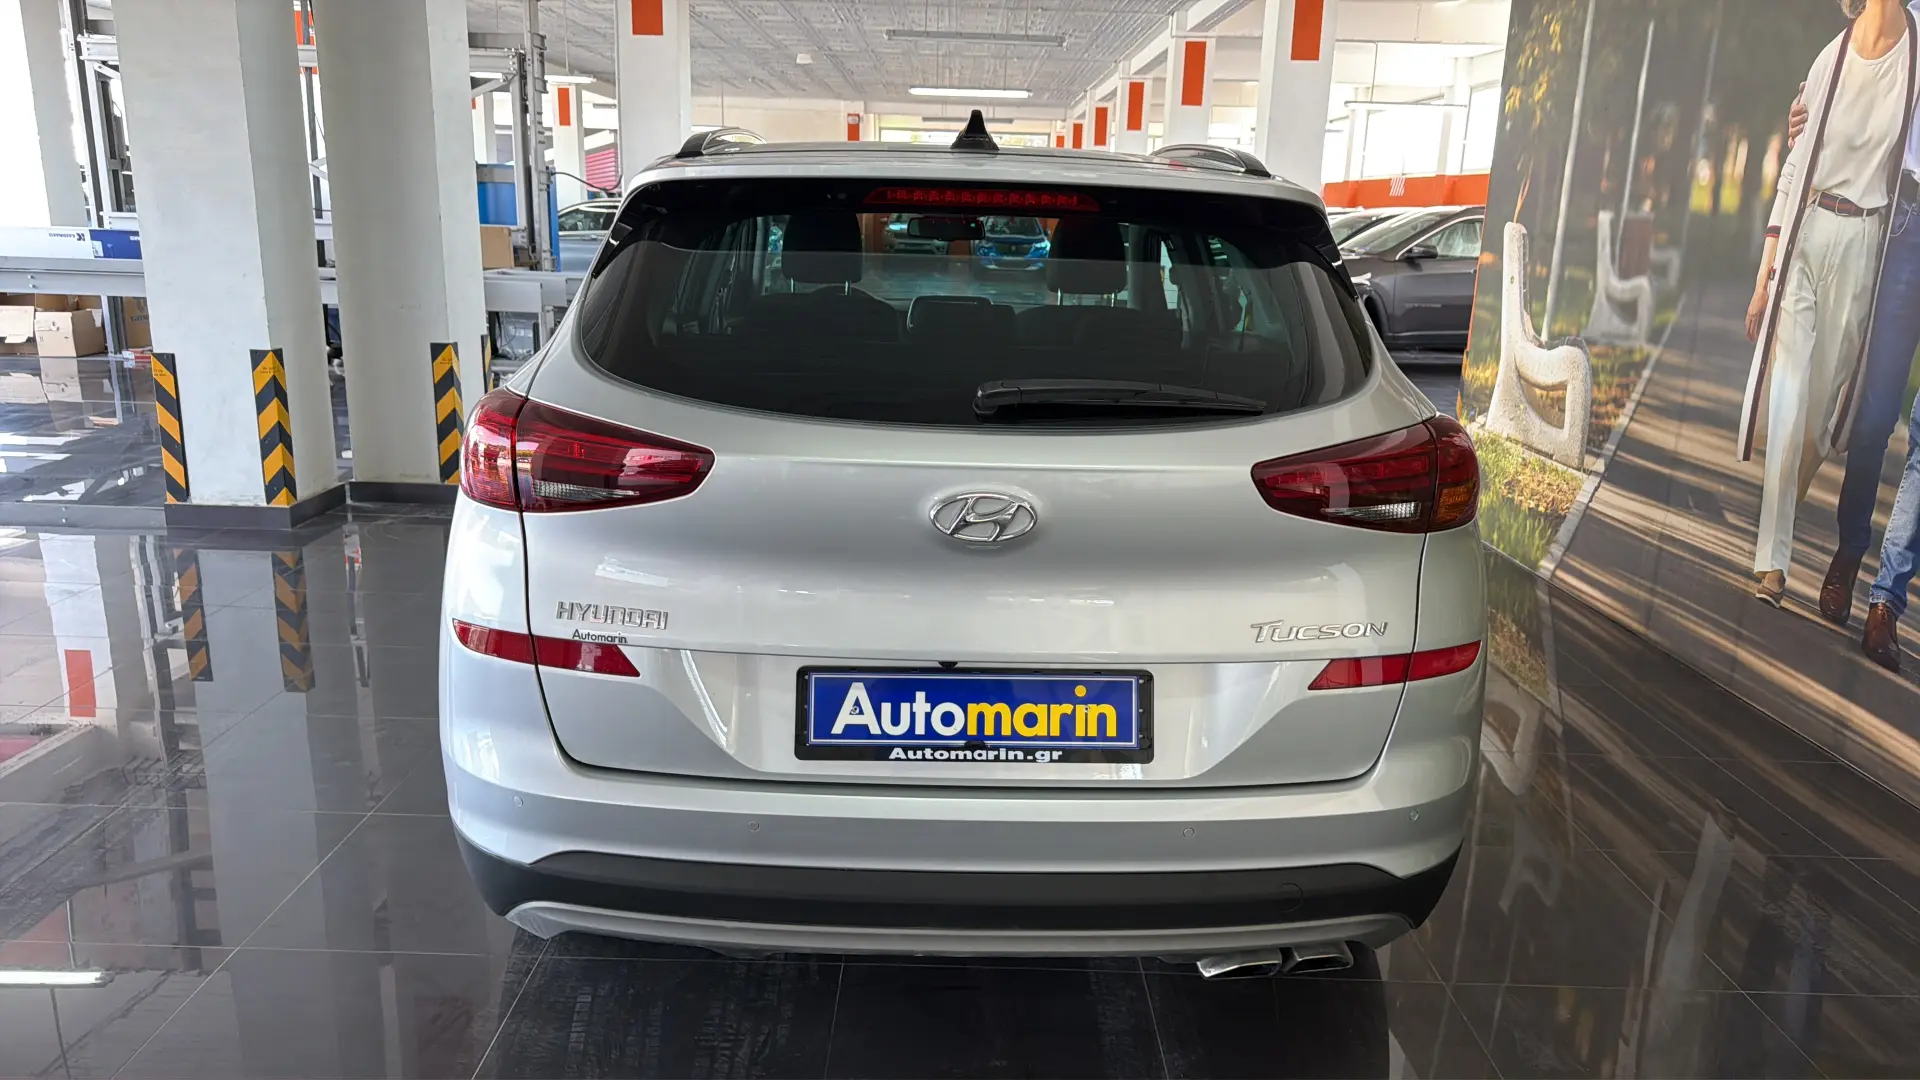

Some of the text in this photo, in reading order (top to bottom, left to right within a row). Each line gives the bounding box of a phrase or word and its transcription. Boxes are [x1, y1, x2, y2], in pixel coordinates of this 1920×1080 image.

[556, 600, 669, 630] HYUNDAI
[572, 628, 627, 644] Automarin
[1250, 619, 1388, 643] TUCSON
[830, 681, 1117, 738] Automarin
[888, 747, 1063, 763] Automarin.gr
